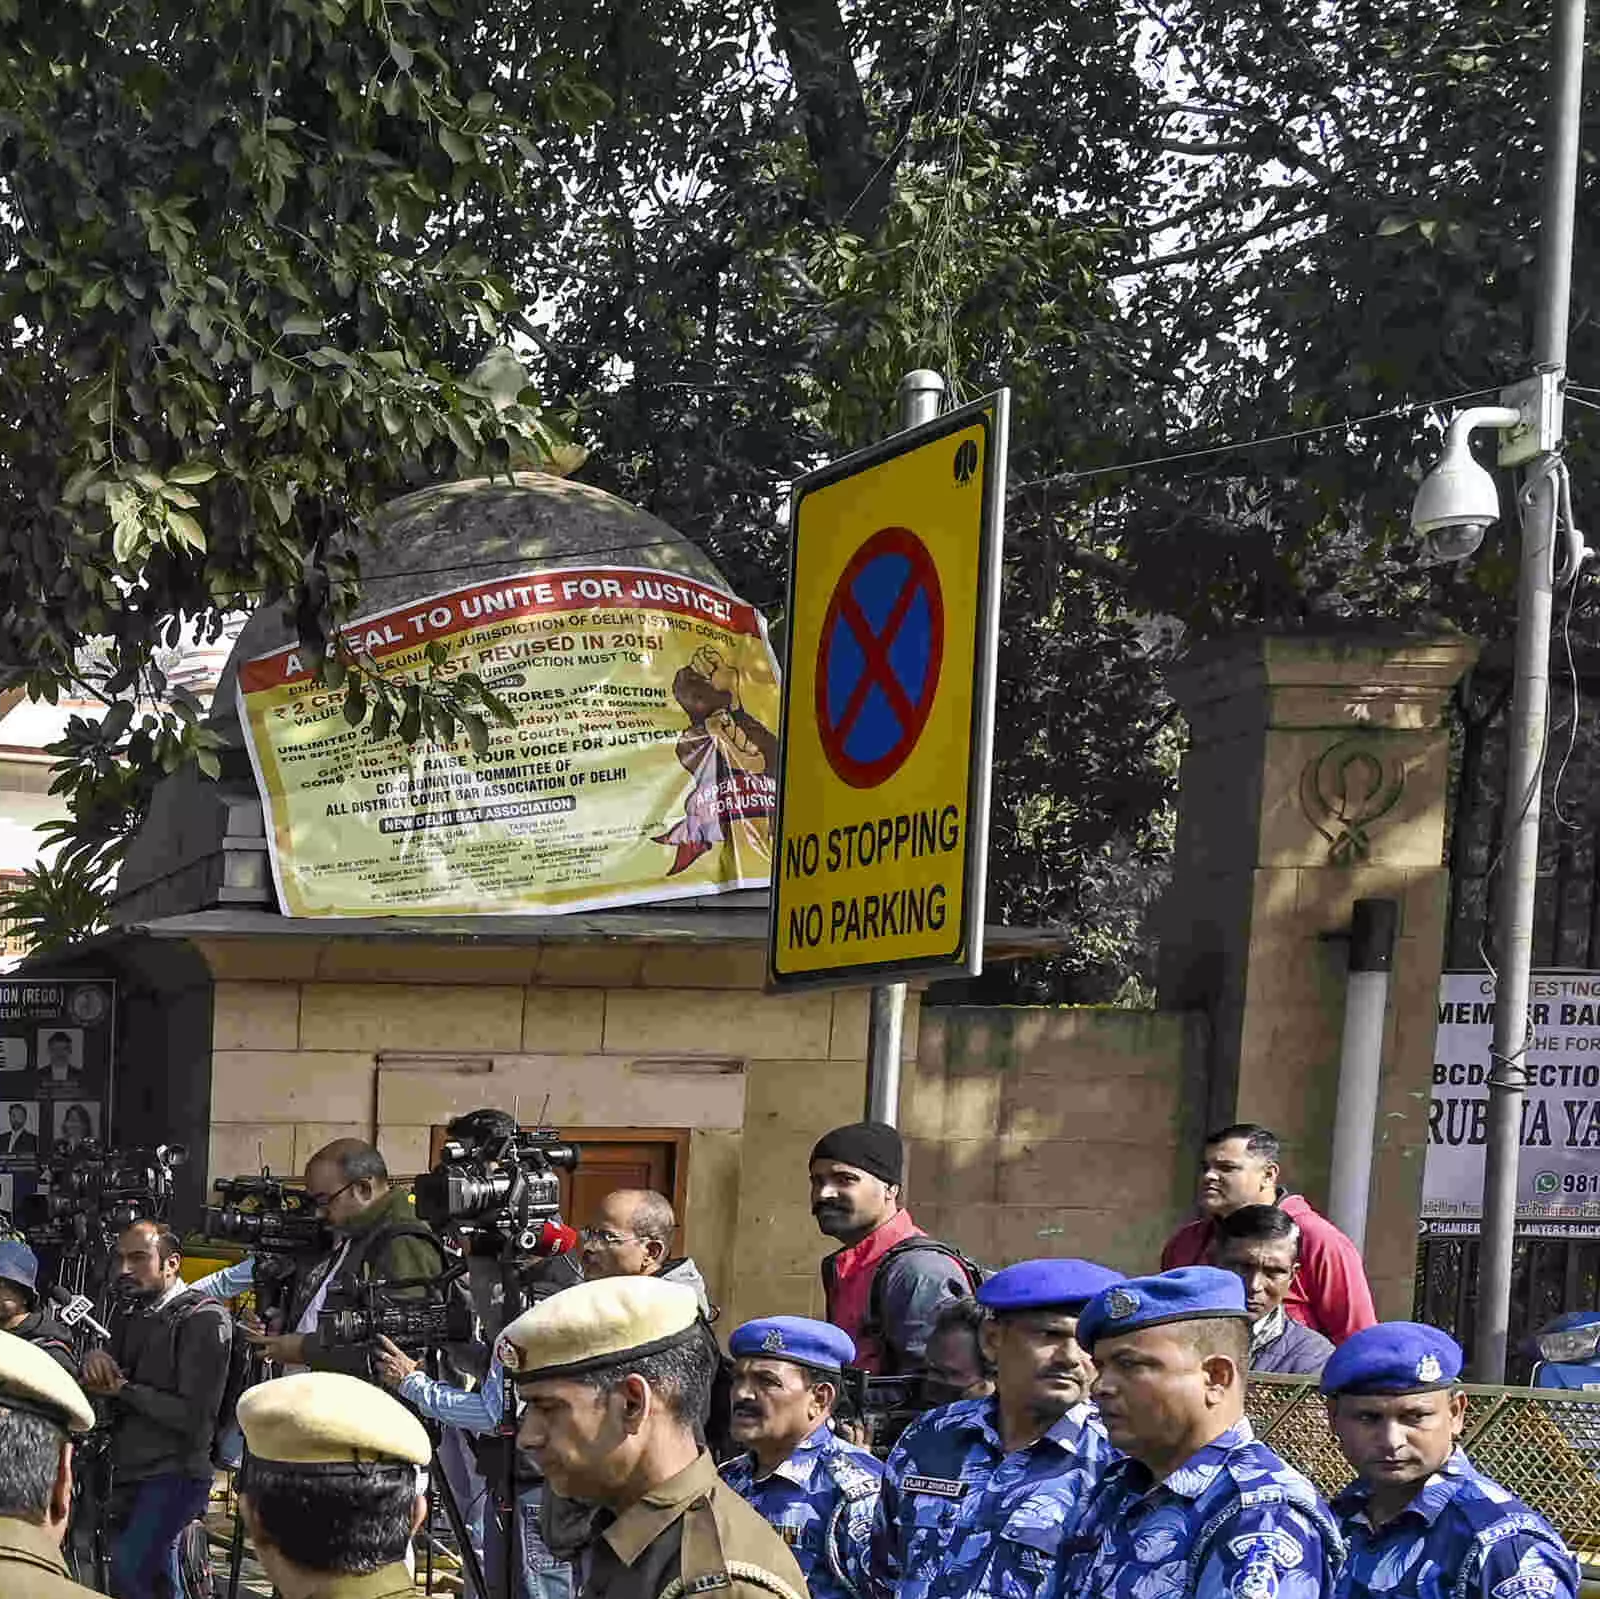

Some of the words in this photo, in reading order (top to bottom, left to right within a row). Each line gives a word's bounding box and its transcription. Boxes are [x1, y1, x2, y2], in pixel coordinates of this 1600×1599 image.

[286, 624, 403, 677] APEAL
[408, 608, 452, 633] TO
[461, 583, 554, 619] UNITE
[562, 578, 624, 600] FOR
[631, 580, 733, 621] JUSTICE!
[460, 617, 564, 648] JURISDICTION
[568, 615, 588, 627] OF
[592, 613, 634, 626] DELHI
[639, 614, 694, 633] DISTRICT
[414, 656, 471, 682] LAST
[478, 635, 575, 664] REVISED
[583, 636, 604, 650] IN
[612, 634, 663, 650] 2015!
[477, 656, 573, 679] JURISDICTION
[577, 652, 616, 666] MUST
[278, 731, 357, 754] UNLIMITED
[500, 688, 564, 704] CRORES
[518, 726, 575, 742] Courts,
[579, 722, 612, 735] New
[616, 718, 655, 730] Delhi
[361, 764, 409, 779] UNITE
[424, 756, 468, 771] RAISE
[473, 747, 516, 765] YOUR
[520, 742, 568, 757] VOICE
[573, 738, 604, 751] FOR
[476, 761, 551, 781] COMMITTEE
[556, 759, 571, 772] OF
[326, 803, 350, 817] ALL
[353, 797, 406, 814] DISTRICT
[411, 790, 450, 807] COURT
[455, 785, 479, 800] BAR
[484, 776, 565, 797] ASSOCIATION
[570, 774, 585, 786] OF
[590, 767, 626, 783] DELHI
[384, 817, 413, 832] NEW
[416, 812, 452, 828] DELHI
[456, 809, 482, 823] BAR
[485, 798, 571, 819] ASSOCIATION
[787, 833, 819, 880] NO
[826, 805, 959, 873] STOPPING
[789, 904, 823, 949] NO
[831, 884, 946, 945] PARKING
[1431, 1222, 1481, 1233] CHAMBER
[66, 1299, 90, 1321] ANI
